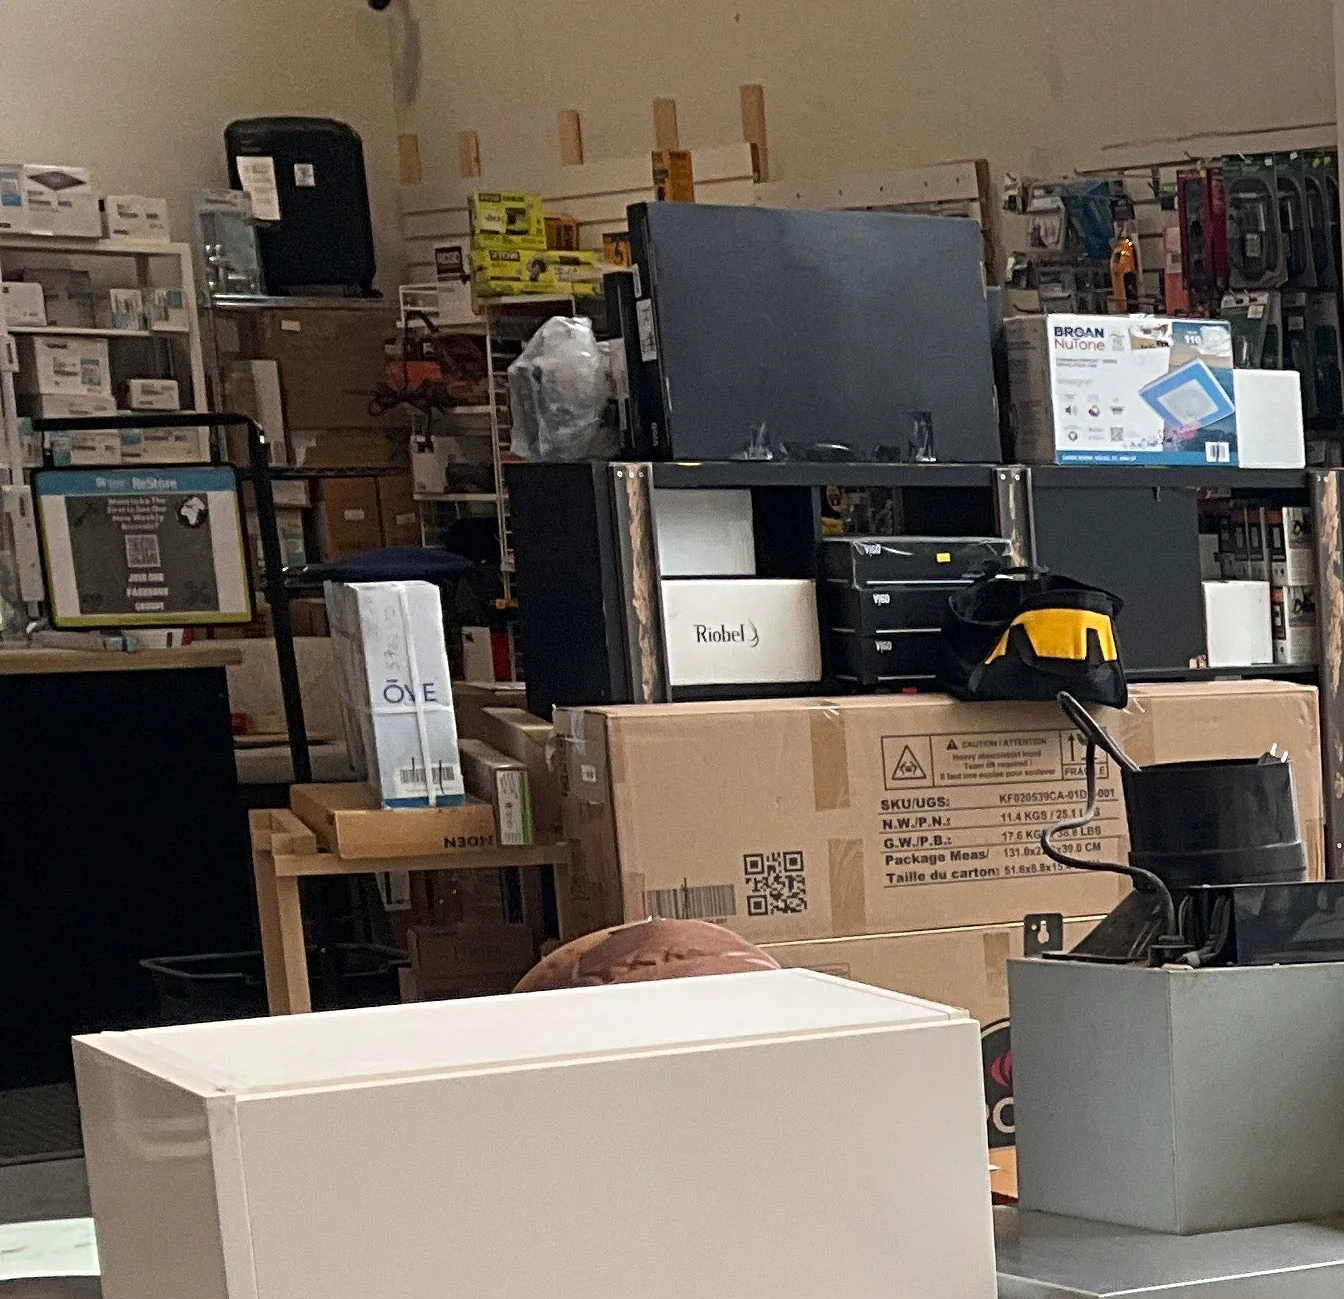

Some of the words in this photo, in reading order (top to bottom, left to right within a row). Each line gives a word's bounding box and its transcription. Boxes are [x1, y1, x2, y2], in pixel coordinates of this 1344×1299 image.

[1054, 326, 1104, 338] BROAN
[1054, 338, 1105, 351] NuTone
[132, 477, 177, 489] ReStore
[694, 624, 745, 643] Riobel
[881, 796, 951, 811] SKU/UGS:
[1001, 812, 1021, 823] 11.4
[1024, 811, 1048, 821] KGS
[1055, 808, 1076, 819] 25.1
[1079, 806, 1101, 819] LS
[443, 834, 495, 848] MOEN
[1001, 830, 1023, 842] 17.6
[1080, 825, 1102, 837] LBS
[885, 853, 946, 867] Package
[950, 848, 989, 862] Meas/
[1085, 841, 1102, 852] CM
[886, 870, 926, 884] Taille
[930, 870, 947, 881] du
[951, 867, 999, 879] carton:
